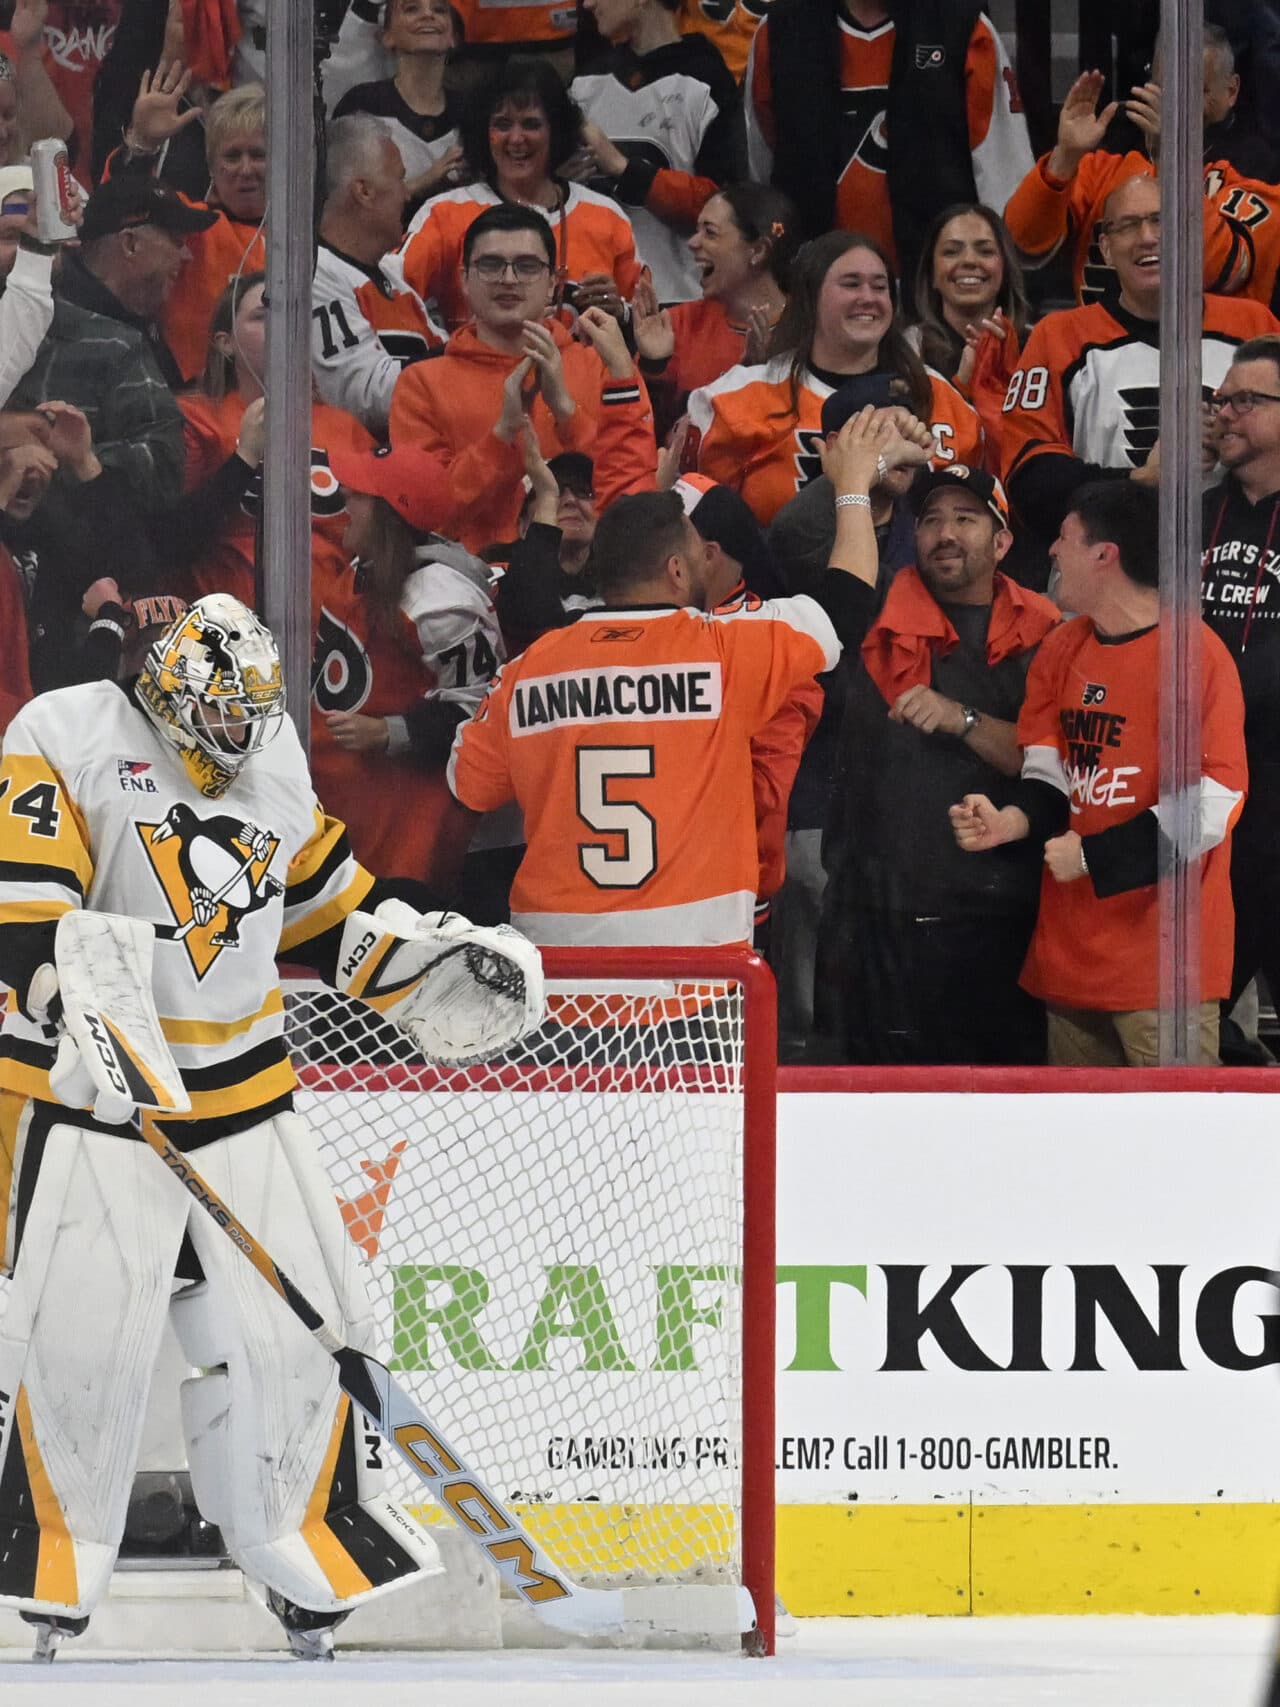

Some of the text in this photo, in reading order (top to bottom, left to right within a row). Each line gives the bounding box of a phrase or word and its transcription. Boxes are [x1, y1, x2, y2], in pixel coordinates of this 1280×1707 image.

[1220, 188, 1272, 231] 17
[1001, 366, 1050, 412] 88
[931, 422, 955, 460] C
[1220, 583, 1271, 605] CREW
[515, 671, 712, 729] IANNACONE
[575, 744, 658, 890] 5
[342, 930, 377, 978] CCM
[83, 1012, 127, 1096] CCM
[163, 1145, 253, 1254] TACKS PRO
[386, 1264, 1280, 1372] RAFTKING
[547, 1435, 1120, 1470] GAMBLING PREM? Call 1-800-GAMBLER.
[385, 1503, 416, 1536] TACKS
[392, 1421, 573, 1604] CCM
